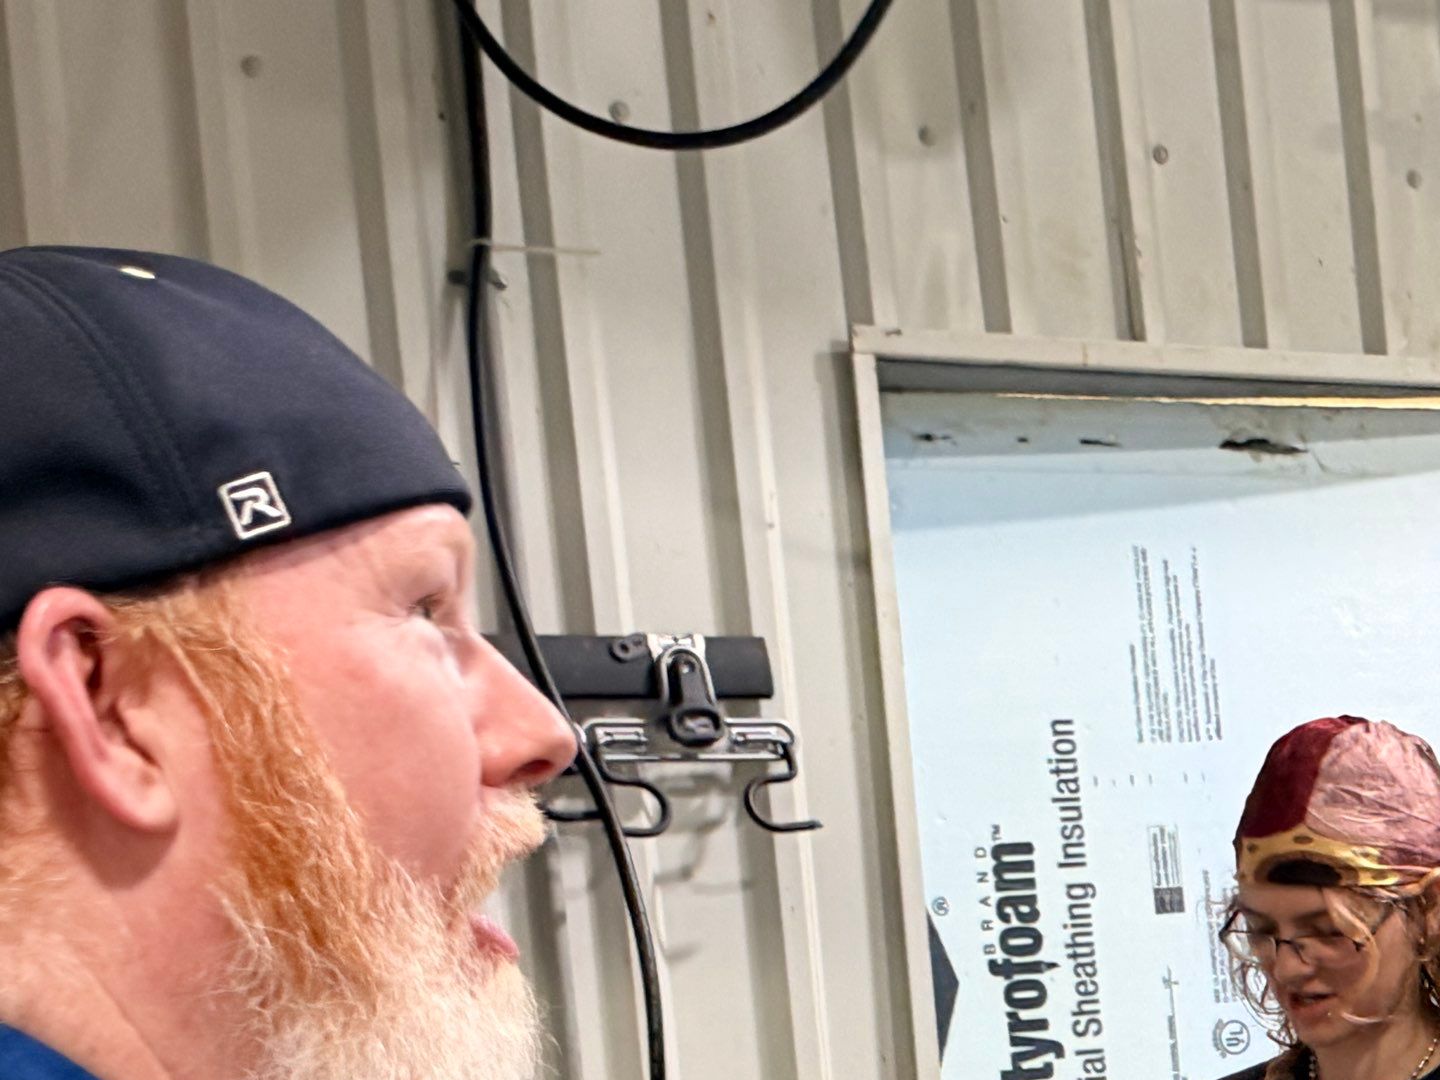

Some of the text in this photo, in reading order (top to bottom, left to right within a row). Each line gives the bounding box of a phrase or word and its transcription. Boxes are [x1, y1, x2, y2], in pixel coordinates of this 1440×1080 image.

[1049, 718, 1088, 870] Insulation
[974, 846, 997, 956] BRAND
[1058, 881, 1103, 1039] Sheathing
